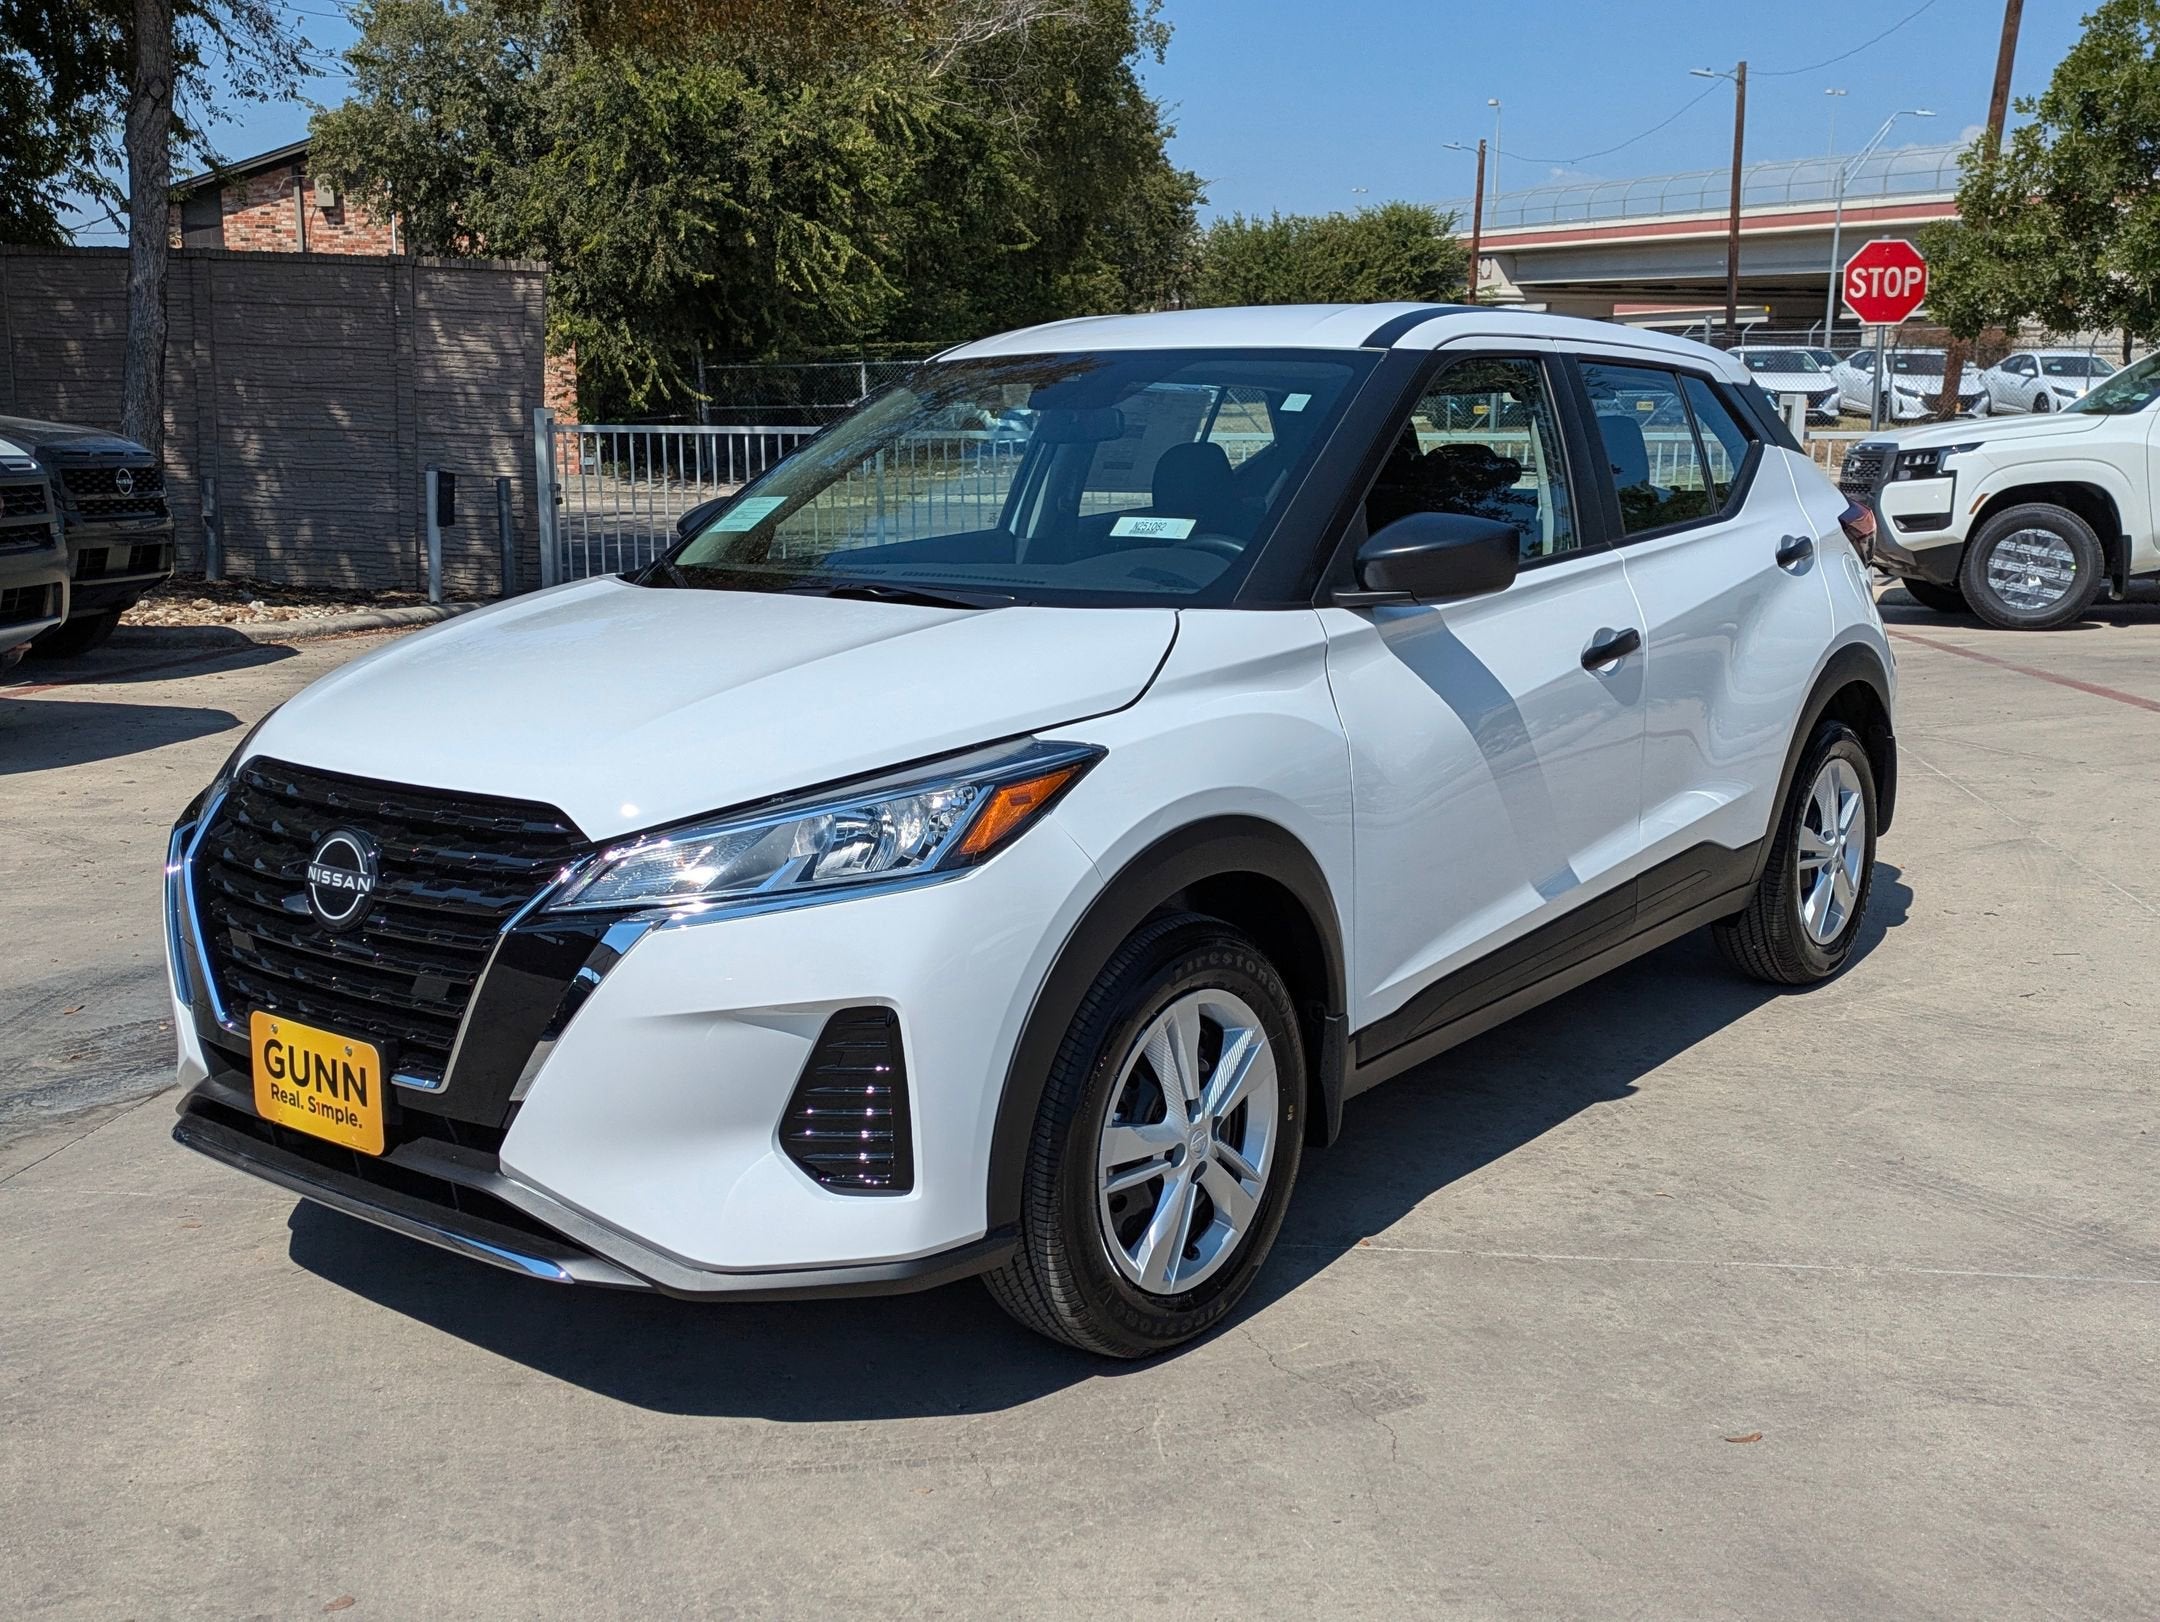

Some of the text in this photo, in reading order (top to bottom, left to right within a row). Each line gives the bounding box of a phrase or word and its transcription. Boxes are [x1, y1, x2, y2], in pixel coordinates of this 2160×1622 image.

[1849, 266, 1923, 298] STOP
[308, 865, 371, 892] NISSAN
[263, 1038, 368, 1108] GUNN
[270, 1082, 304, 1110] Real.
